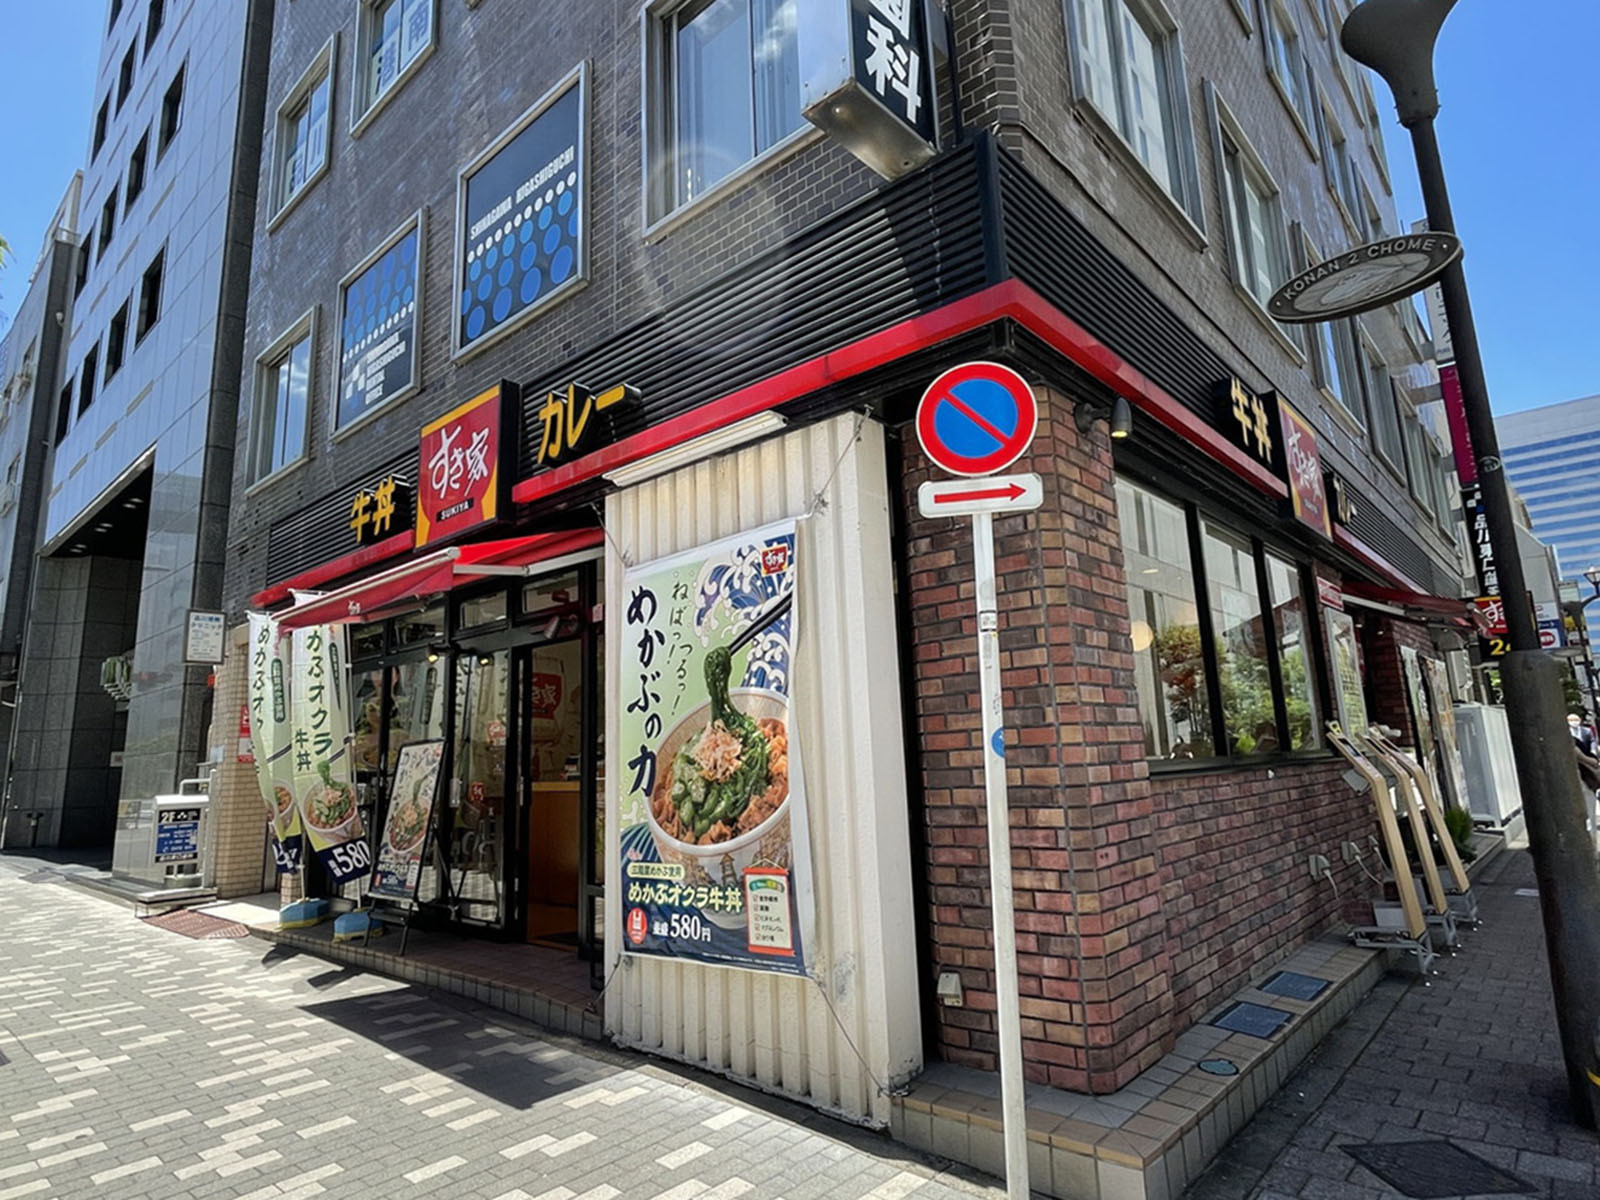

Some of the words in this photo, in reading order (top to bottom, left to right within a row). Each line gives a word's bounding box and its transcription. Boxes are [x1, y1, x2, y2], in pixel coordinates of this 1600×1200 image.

[1283, 261, 1341, 300] KONAN
[1348, 253, 1360, 266] 2
[1367, 238, 1436, 258] CHOME
[537, 382, 625, 465] カレー
[1231, 376, 1273, 464] 牛丼
[428, 424, 490, 499] すき家
[350, 473, 397, 543] 牛丼
[440, 500, 470, 521] SUKIYA
[1489, 639, 1511, 656] 2
[305, 623, 333, 756] かぶオクラ
[626, 585, 666, 798] めかぶの力
[295, 728, 312, 772] 牛丼
[161, 811, 176, 824] 2F
[627, 881, 743, 913] めかぶオクラ牛丼
